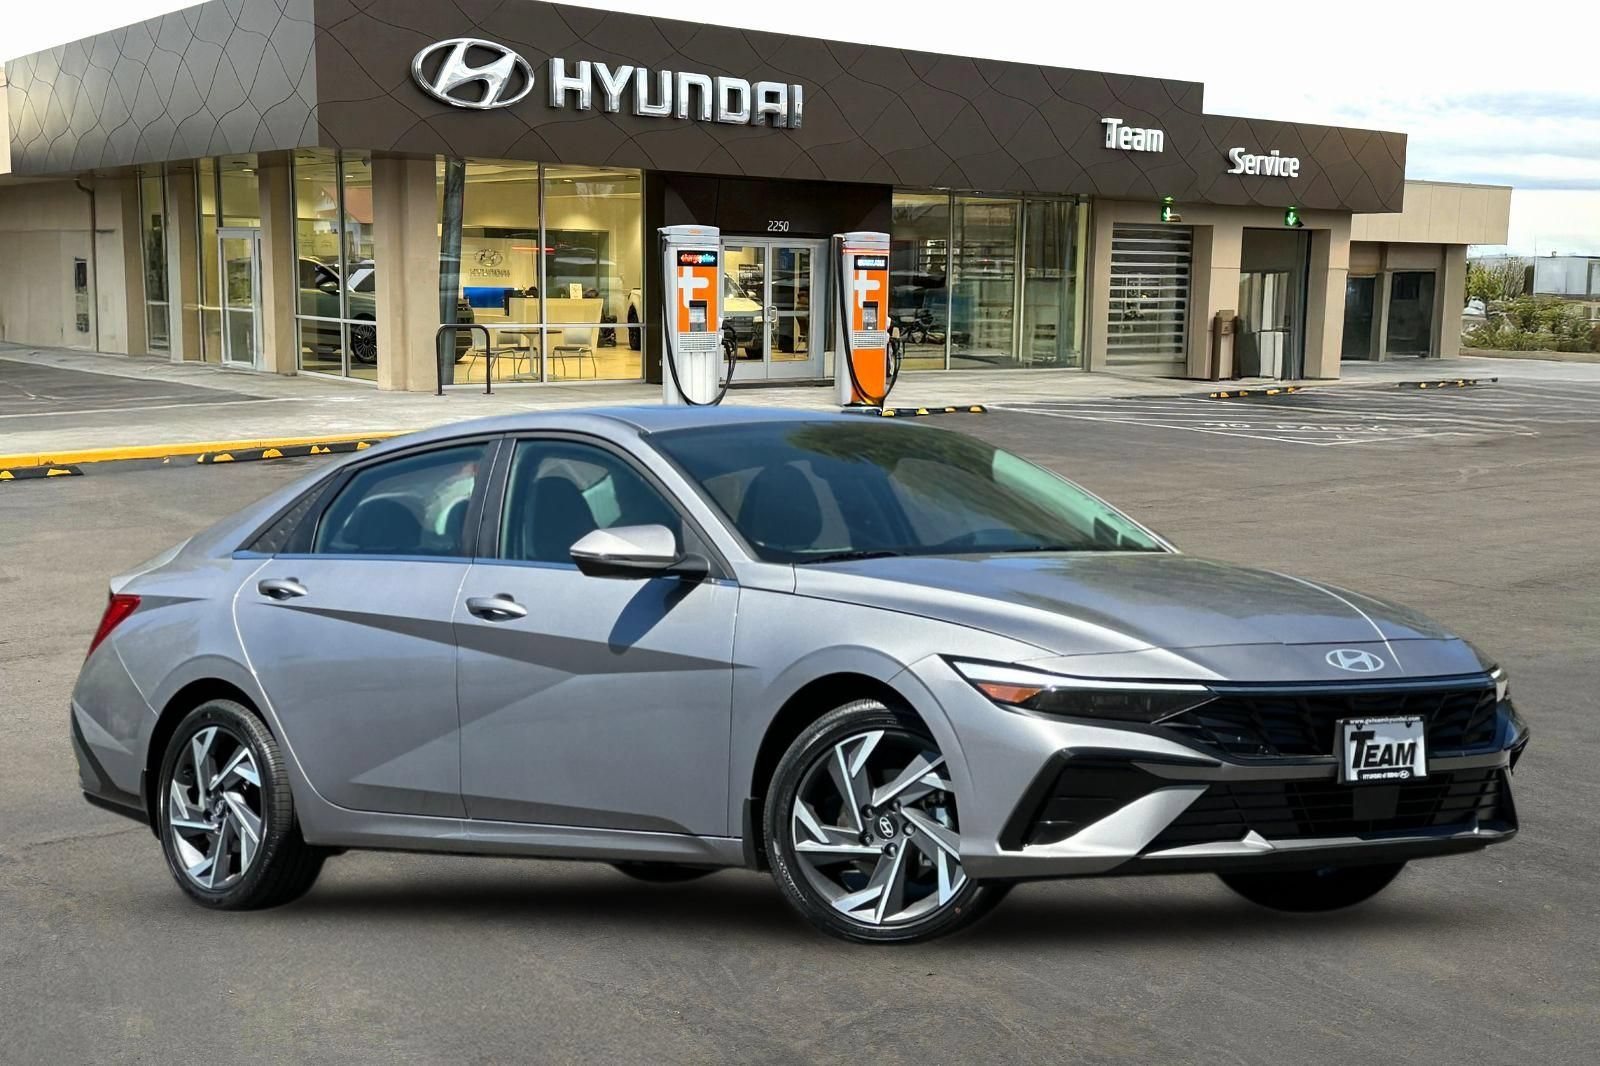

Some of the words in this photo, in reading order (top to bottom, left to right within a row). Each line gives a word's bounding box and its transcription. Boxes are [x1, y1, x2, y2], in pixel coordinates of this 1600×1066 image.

[549, 57, 802, 129] HYUNDAI
[1101, 117, 1164, 152] Team
[1227, 147, 1300, 178] Service
[767, 220, 790, 232] 2250
[1349, 730, 1417, 769] TEAM
